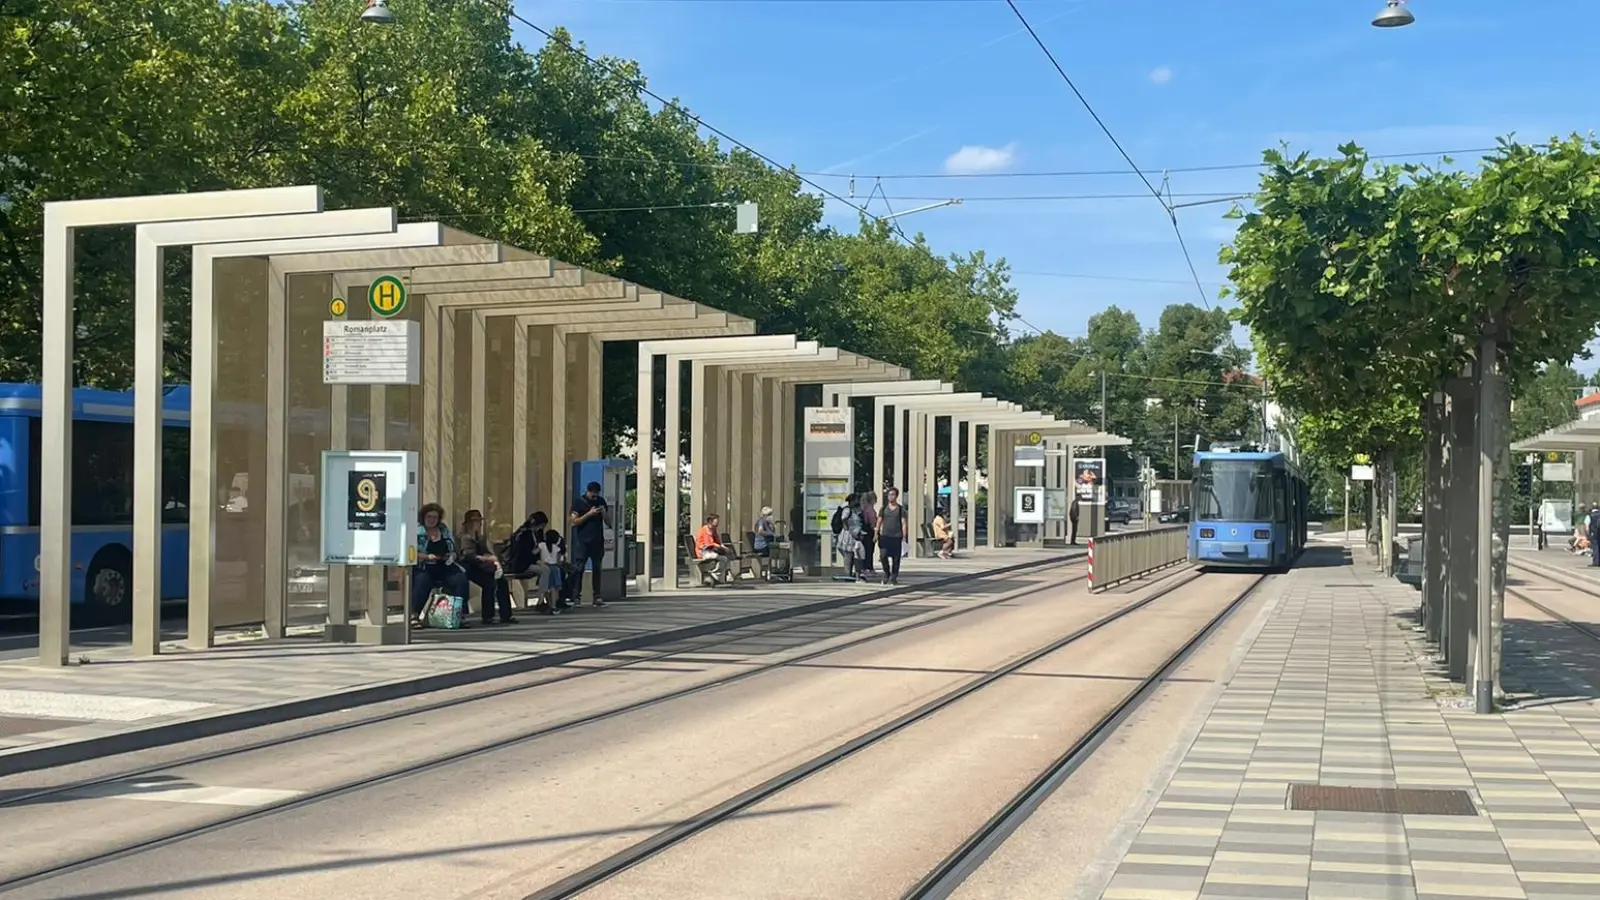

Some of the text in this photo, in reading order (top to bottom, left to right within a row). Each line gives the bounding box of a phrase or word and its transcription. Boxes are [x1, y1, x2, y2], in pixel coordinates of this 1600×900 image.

[380, 285, 394, 307] H
[335, 302, 341, 312] 1
[344, 325, 387, 334] Romanplatz
[357, 478, 376, 512] 9
